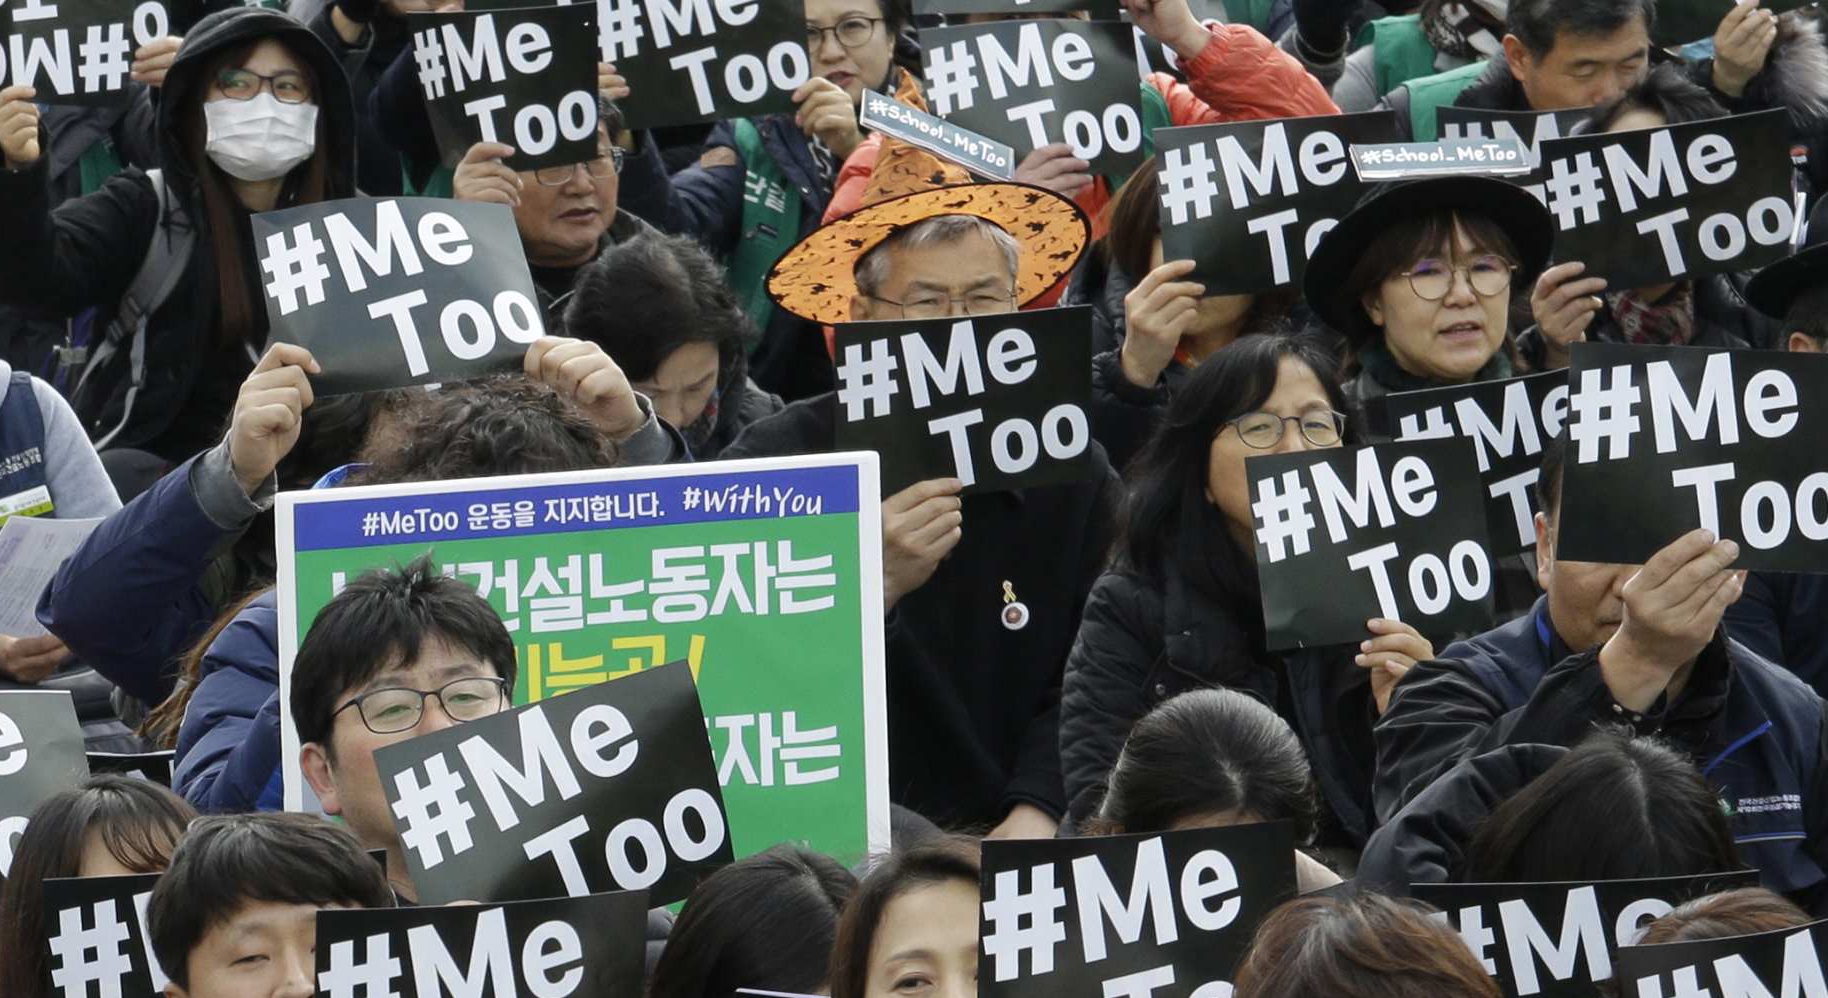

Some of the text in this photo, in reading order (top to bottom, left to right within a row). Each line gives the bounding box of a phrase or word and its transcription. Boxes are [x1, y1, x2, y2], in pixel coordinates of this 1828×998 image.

[414, 14, 552, 100] #Me
[671, 40, 810, 115] Too
[924, 23, 1095, 115] #Me
[465, 90, 596, 155] Too
[868, 98, 1007, 172] #School_MeToo
[1007, 100, 1142, 160] Too
[1361, 143, 1518, 167] #School_MeToo
[1158, 122, 1348, 225] #Me
[1546, 128, 1737, 231] #Me
[261, 200, 472, 315] #Me
[1636, 196, 1793, 276] Too
[368, 290, 543, 377] Too
[837, 320, 1037, 422] #Me
[928, 404, 1089, 486] Too
[1570, 353, 1800, 463] #Me
[362, 484, 823, 537] #MeToo 운동을 지지합니다. #WithYou
[1252, 446, 1438, 562] #Me
[1672, 462, 1828, 550] Too
[332, 540, 837, 635] 건설노동자는
[1348, 541, 1491, 622] Too
[391, 704, 638, 869] #Me
[707, 711, 840, 787] 자는
[523, 788, 724, 897] Too
[982, 836, 1242, 979] #Me
